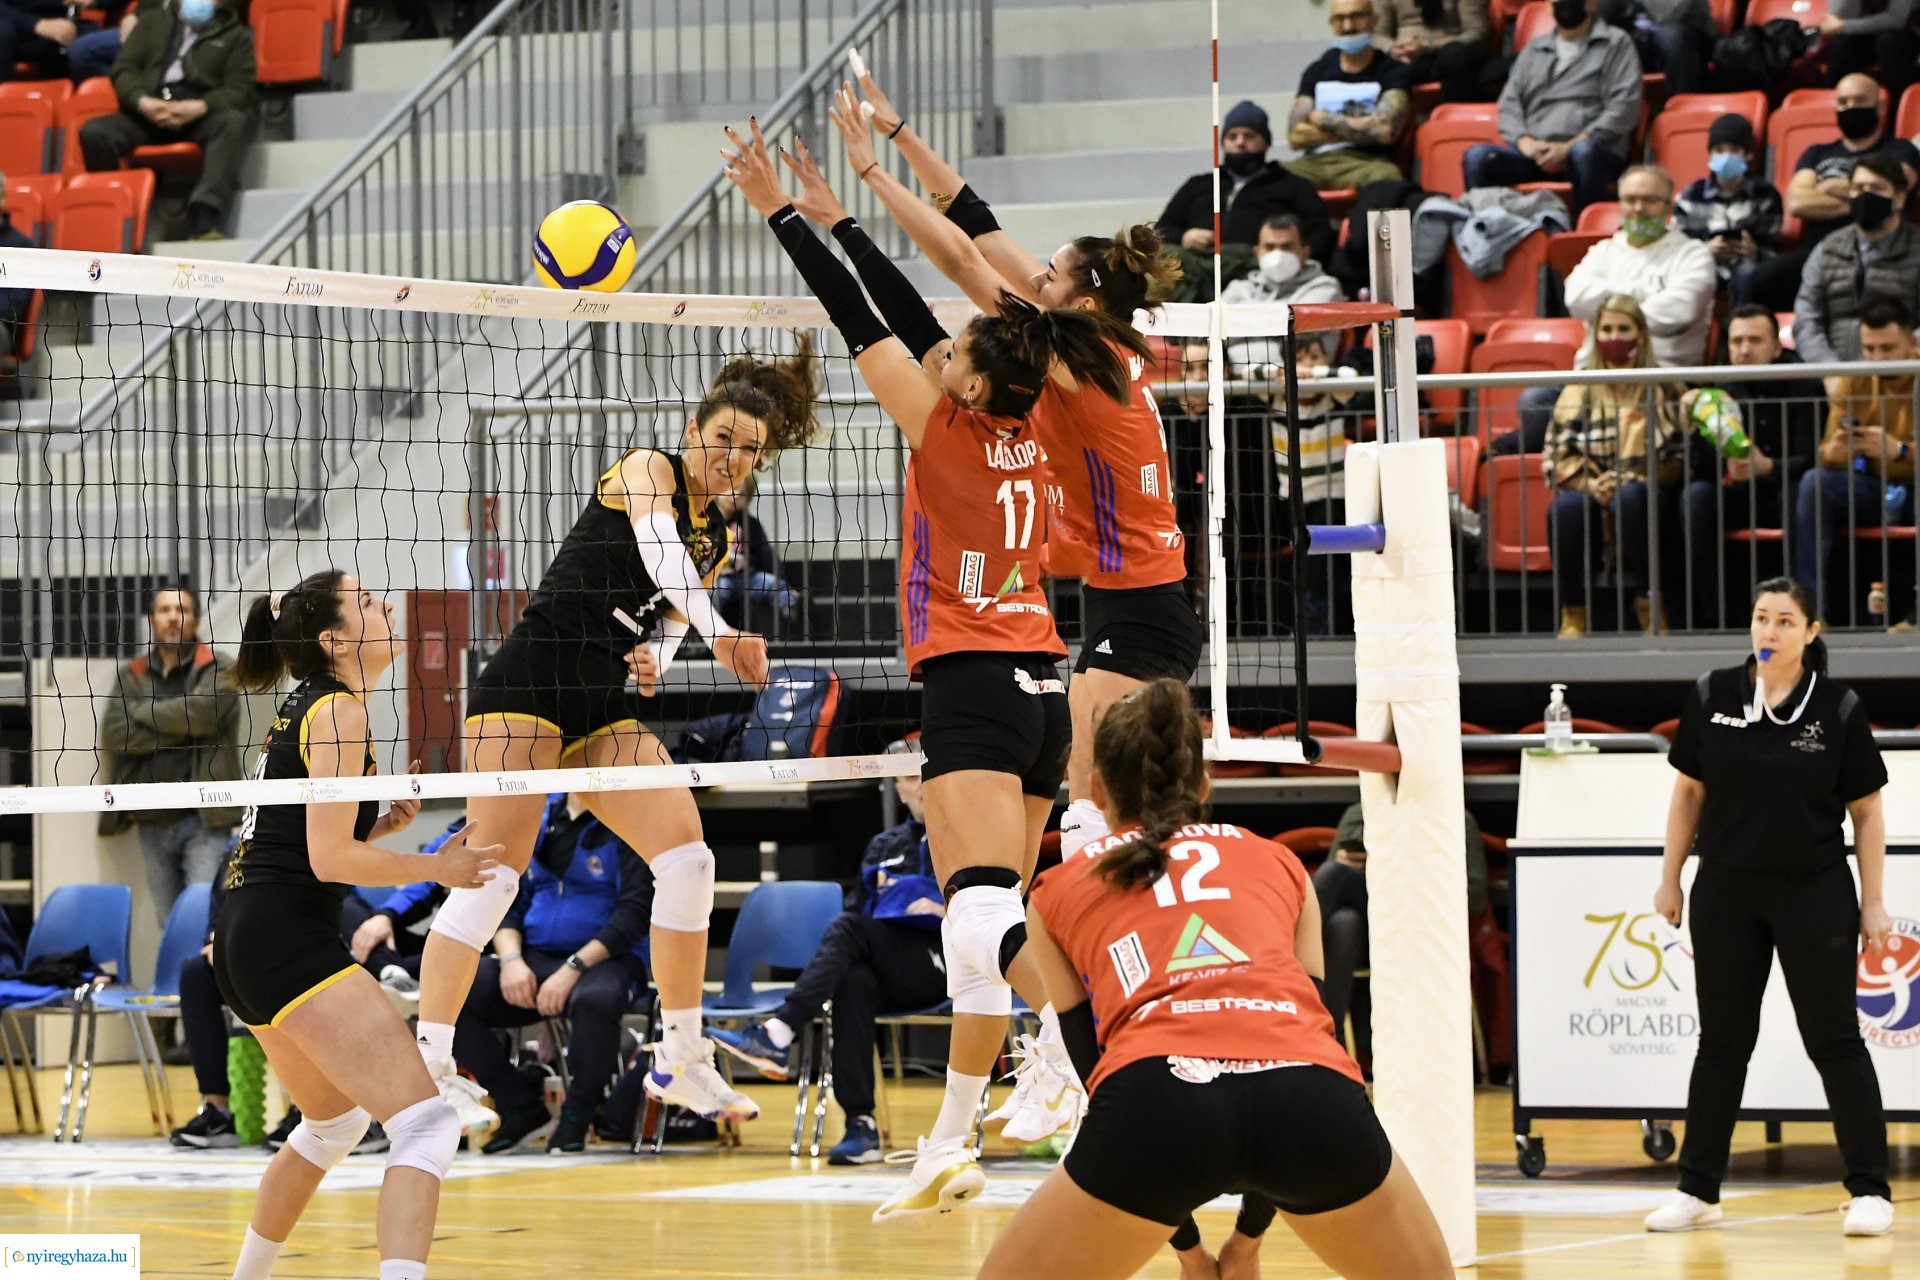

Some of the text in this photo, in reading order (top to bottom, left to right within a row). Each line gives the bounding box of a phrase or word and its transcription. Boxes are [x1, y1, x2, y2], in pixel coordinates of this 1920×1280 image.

[284, 276, 324, 297] FATUM
[996, 479, 1037, 549] 17
[965, 553, 978, 598] TRABAG
[1710, 712, 1748, 729] Zeus
[199, 787, 233, 803] FATUM
[497, 777, 528, 792] FATUM
[1083, 824, 1243, 859] RAOVA
[1152, 840, 1232, 908] 12
[1171, 997, 1297, 1015] BESTRONG
[1615, 996, 1667, 1007] MAGYAR
[1569, 1008, 1699, 1037] RÖPLABD
